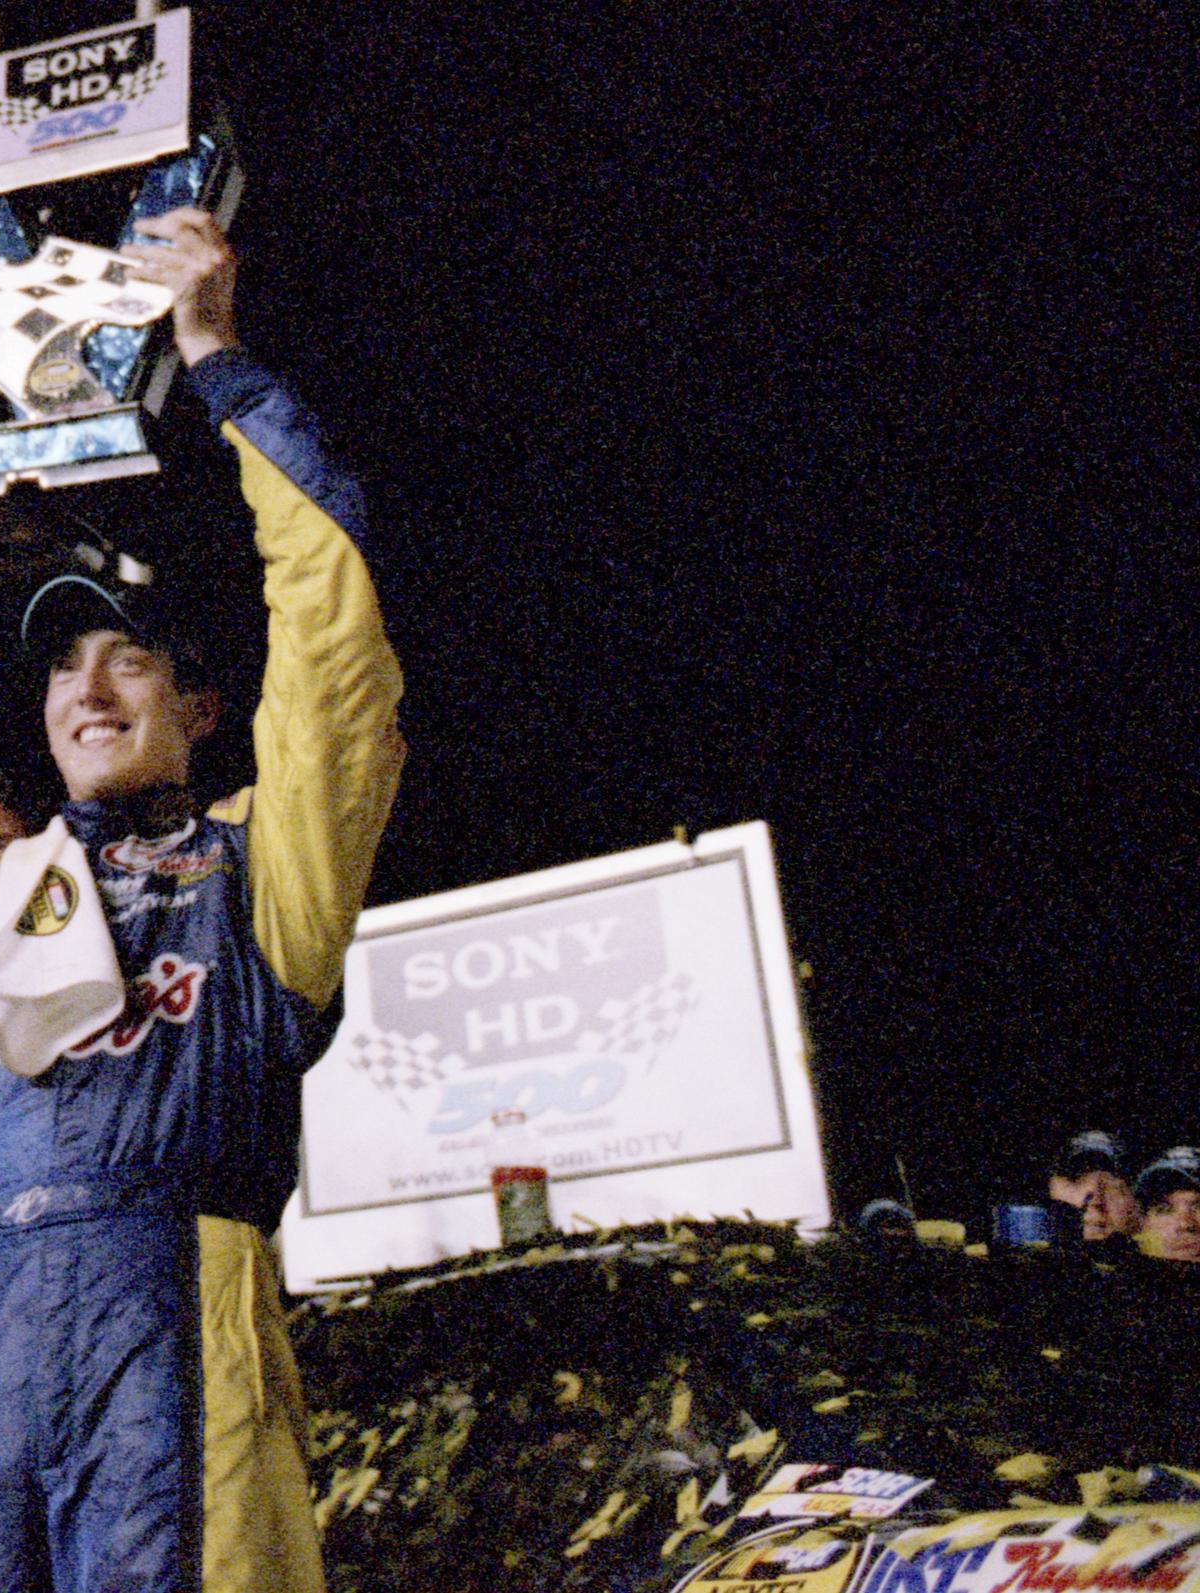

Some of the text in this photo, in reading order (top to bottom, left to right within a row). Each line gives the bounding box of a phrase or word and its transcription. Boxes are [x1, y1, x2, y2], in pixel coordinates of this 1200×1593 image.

[23, 36, 137, 83] SONY
[51, 73, 110, 106] HD
[27, 103, 127, 145] 500
[403, 917, 620, 1000] SONY
[465, 995, 580, 1053] HD
[427, 1058, 628, 1135] 500
